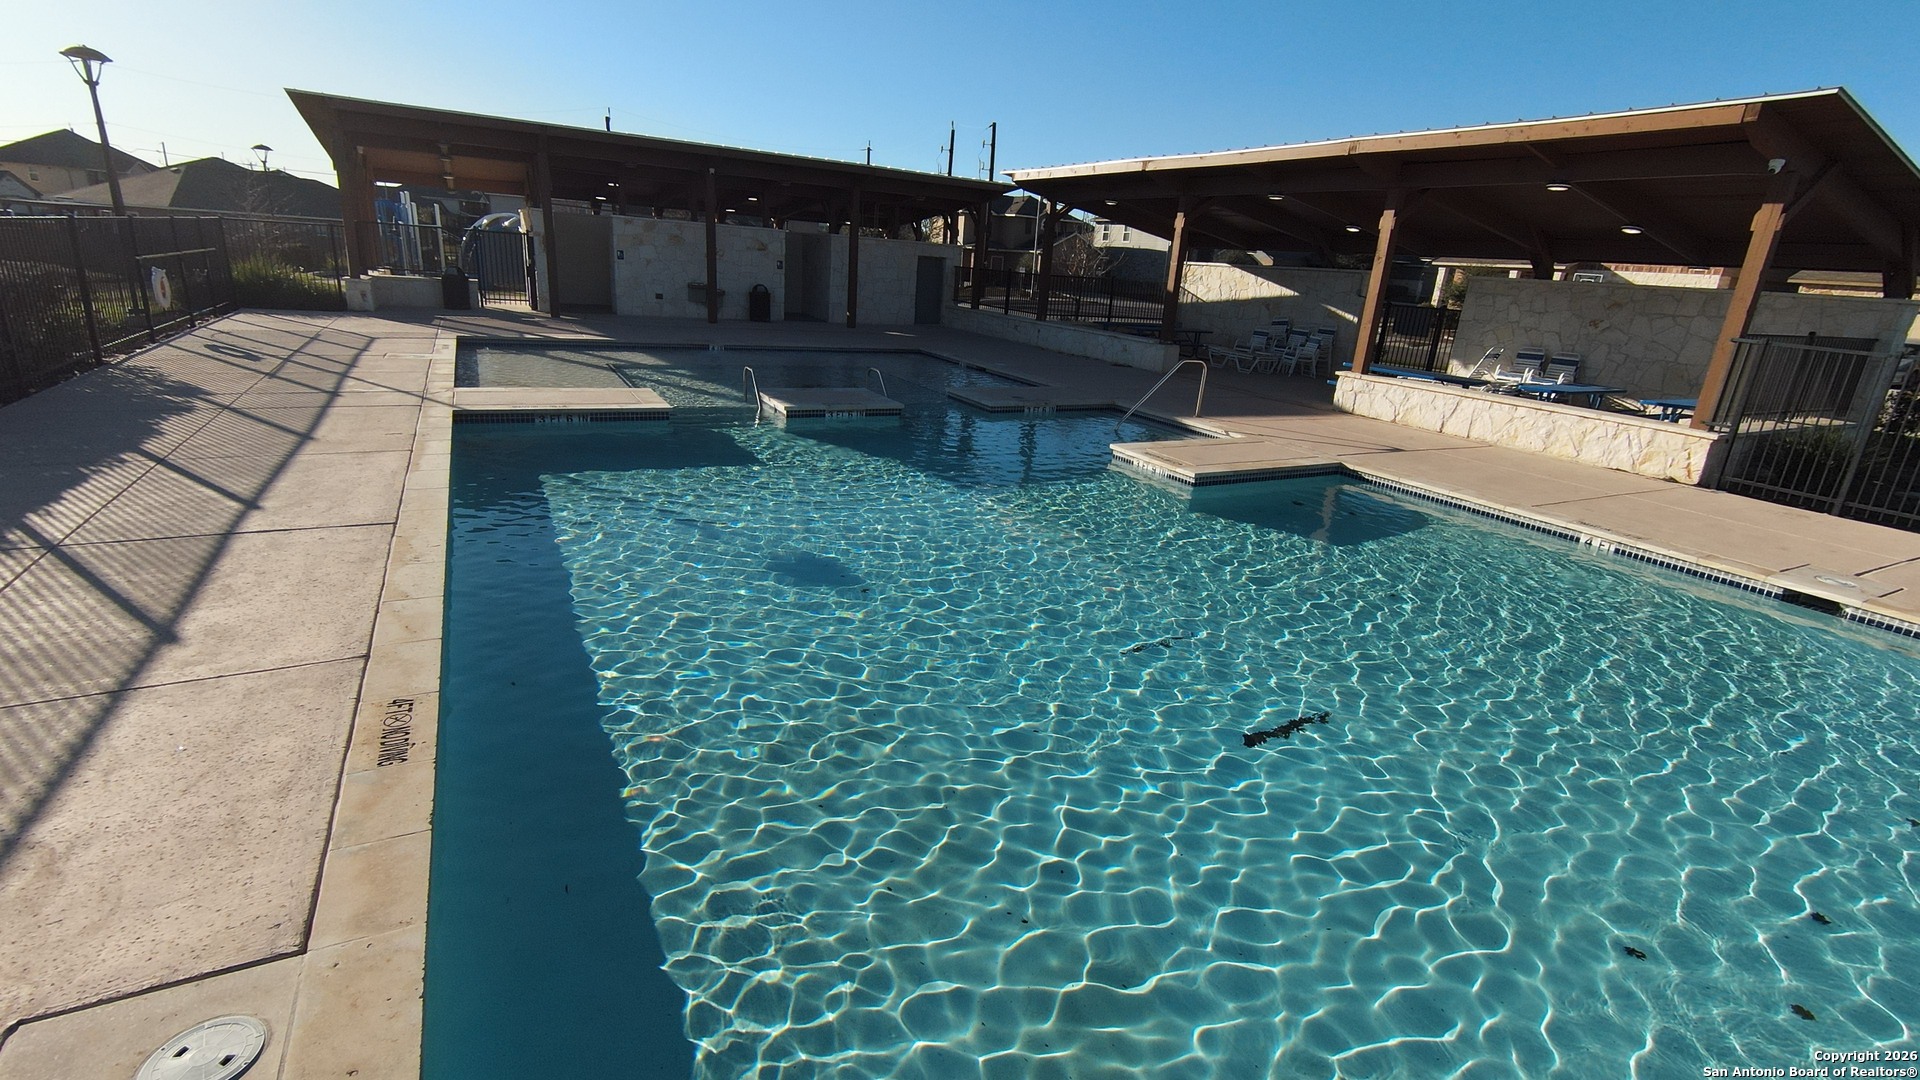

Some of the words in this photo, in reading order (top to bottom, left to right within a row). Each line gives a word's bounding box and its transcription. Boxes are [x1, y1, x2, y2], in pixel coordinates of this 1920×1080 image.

[550, 414, 561, 422] FT
[1584, 537, 1593, 546] 4
[1598, 539, 1615, 552] FT
